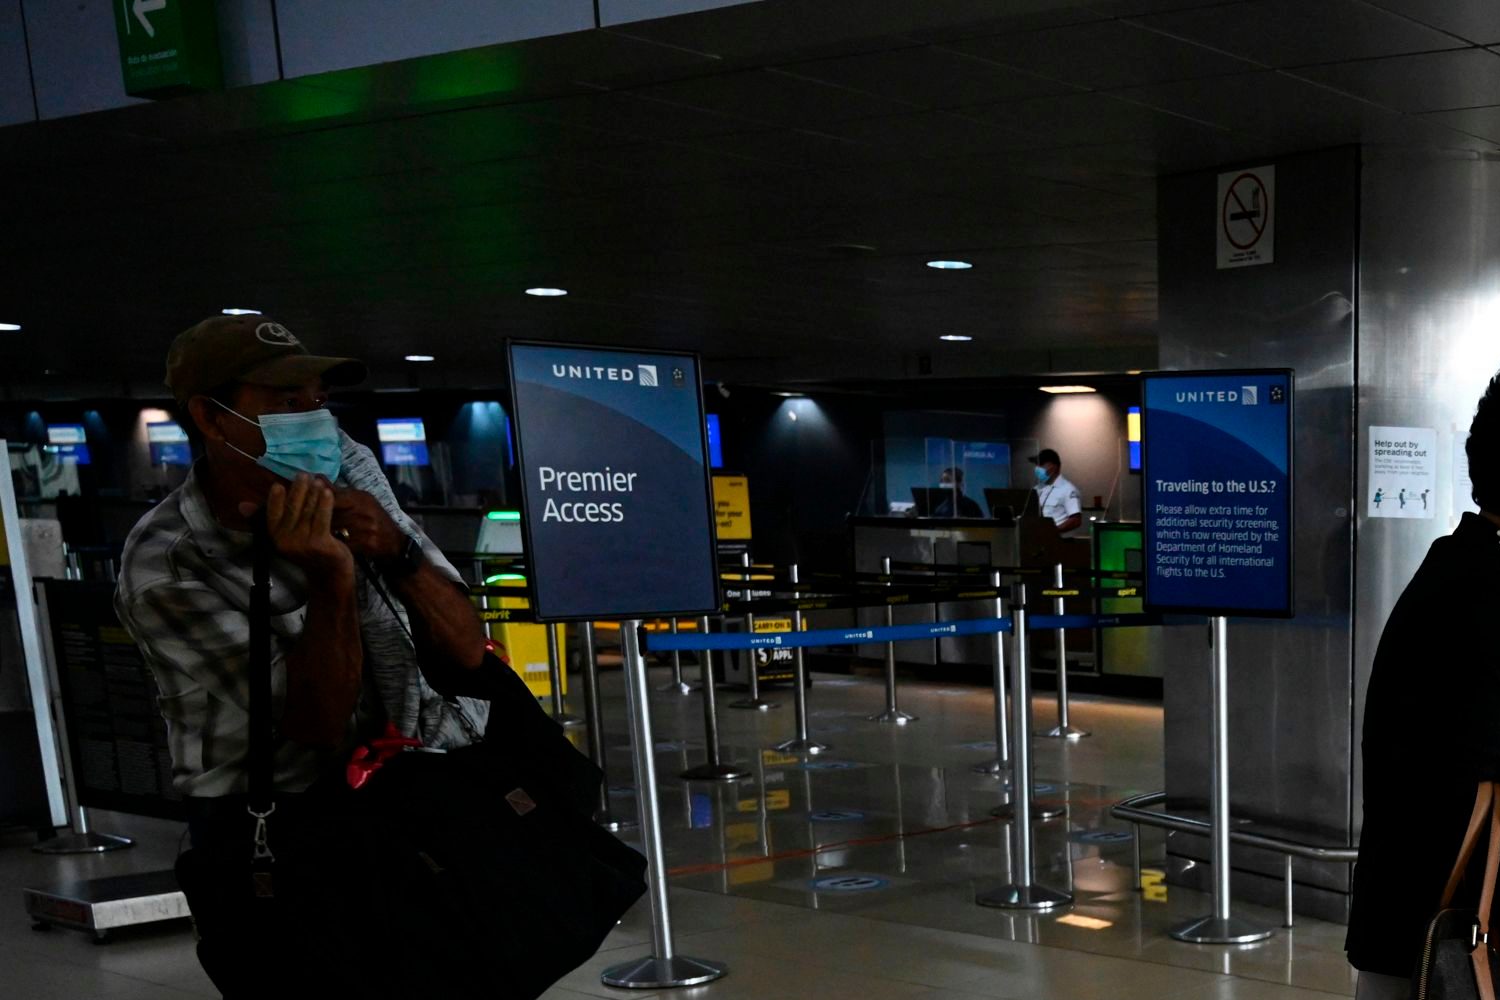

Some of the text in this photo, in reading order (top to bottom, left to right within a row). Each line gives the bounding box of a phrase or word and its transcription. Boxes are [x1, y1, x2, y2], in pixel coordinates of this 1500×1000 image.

[552, 364, 634, 381] UNITED
[1176, 391, 1238, 403] UNITED
[1375, 440, 1392, 448] Help
[1409, 441, 1418, 449] by
[1374, 449, 1412, 457] spreading
[539, 466, 637, 492] Premier
[1156, 480, 1276, 495] Traveling to the U.S.?
[542, 498, 624, 522] Access
[1156, 504, 1268, 516] Please allow extra time for
[1156, 517, 1279, 530] additional security screening,
[1156, 529, 1279, 542] which is now required by the
[1156, 542, 1262, 554] Department of Homeland
[1156, 554, 1274, 567] Security for all international
[1156, 567, 1226, 578] flights to the U.S.
